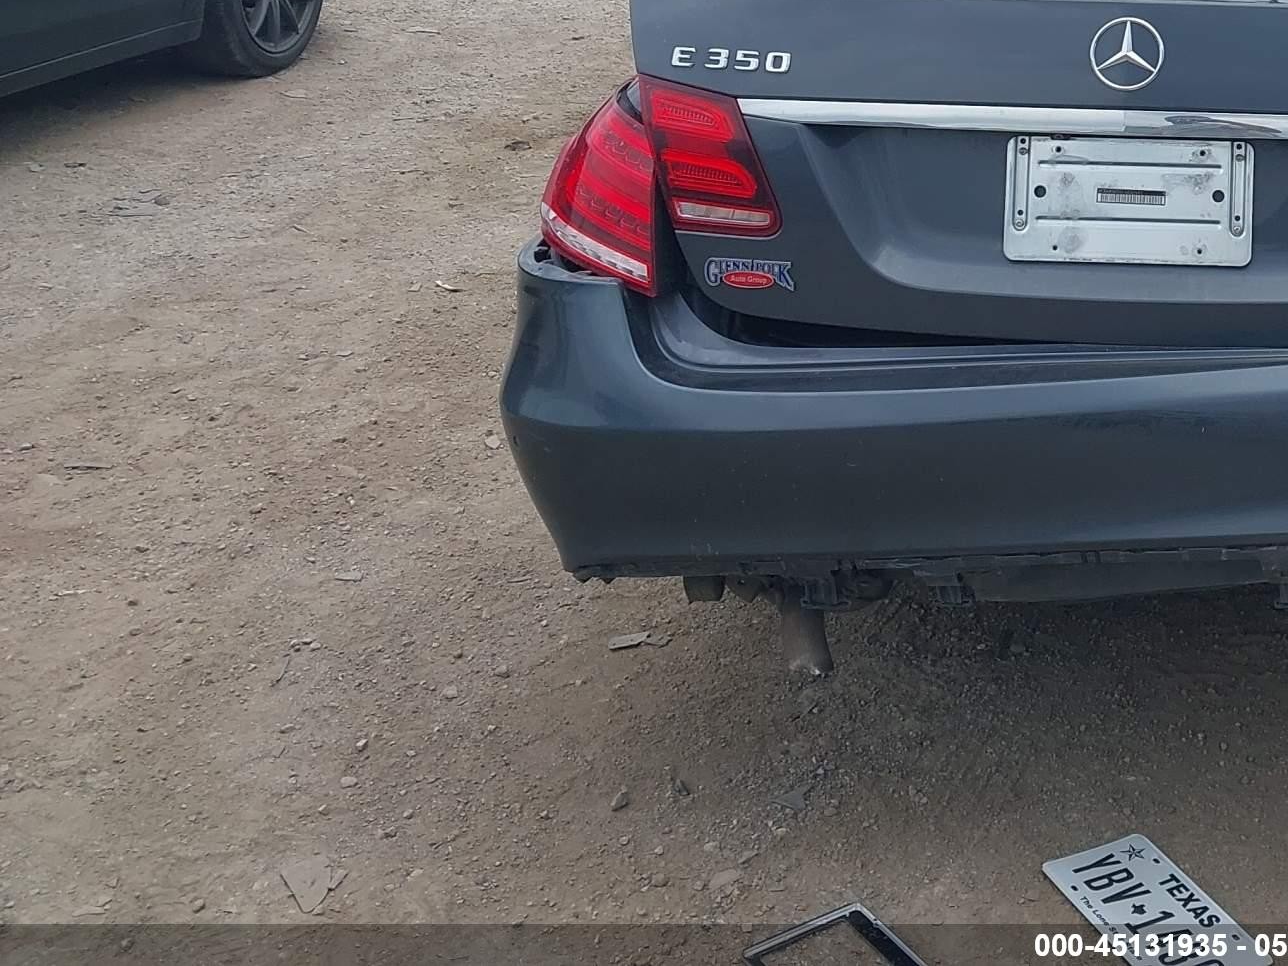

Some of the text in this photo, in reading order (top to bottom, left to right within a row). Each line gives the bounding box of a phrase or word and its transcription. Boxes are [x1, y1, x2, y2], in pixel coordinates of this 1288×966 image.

[671, 46, 791, 73] E 350
[729, 275, 767, 285] Auto Group
[1072, 853, 1152, 904] YBV
[1080, 896, 1093, 909] The
[1092, 909, 1110, 926] Lone
[1158, 873, 1221, 928] TEXAS
